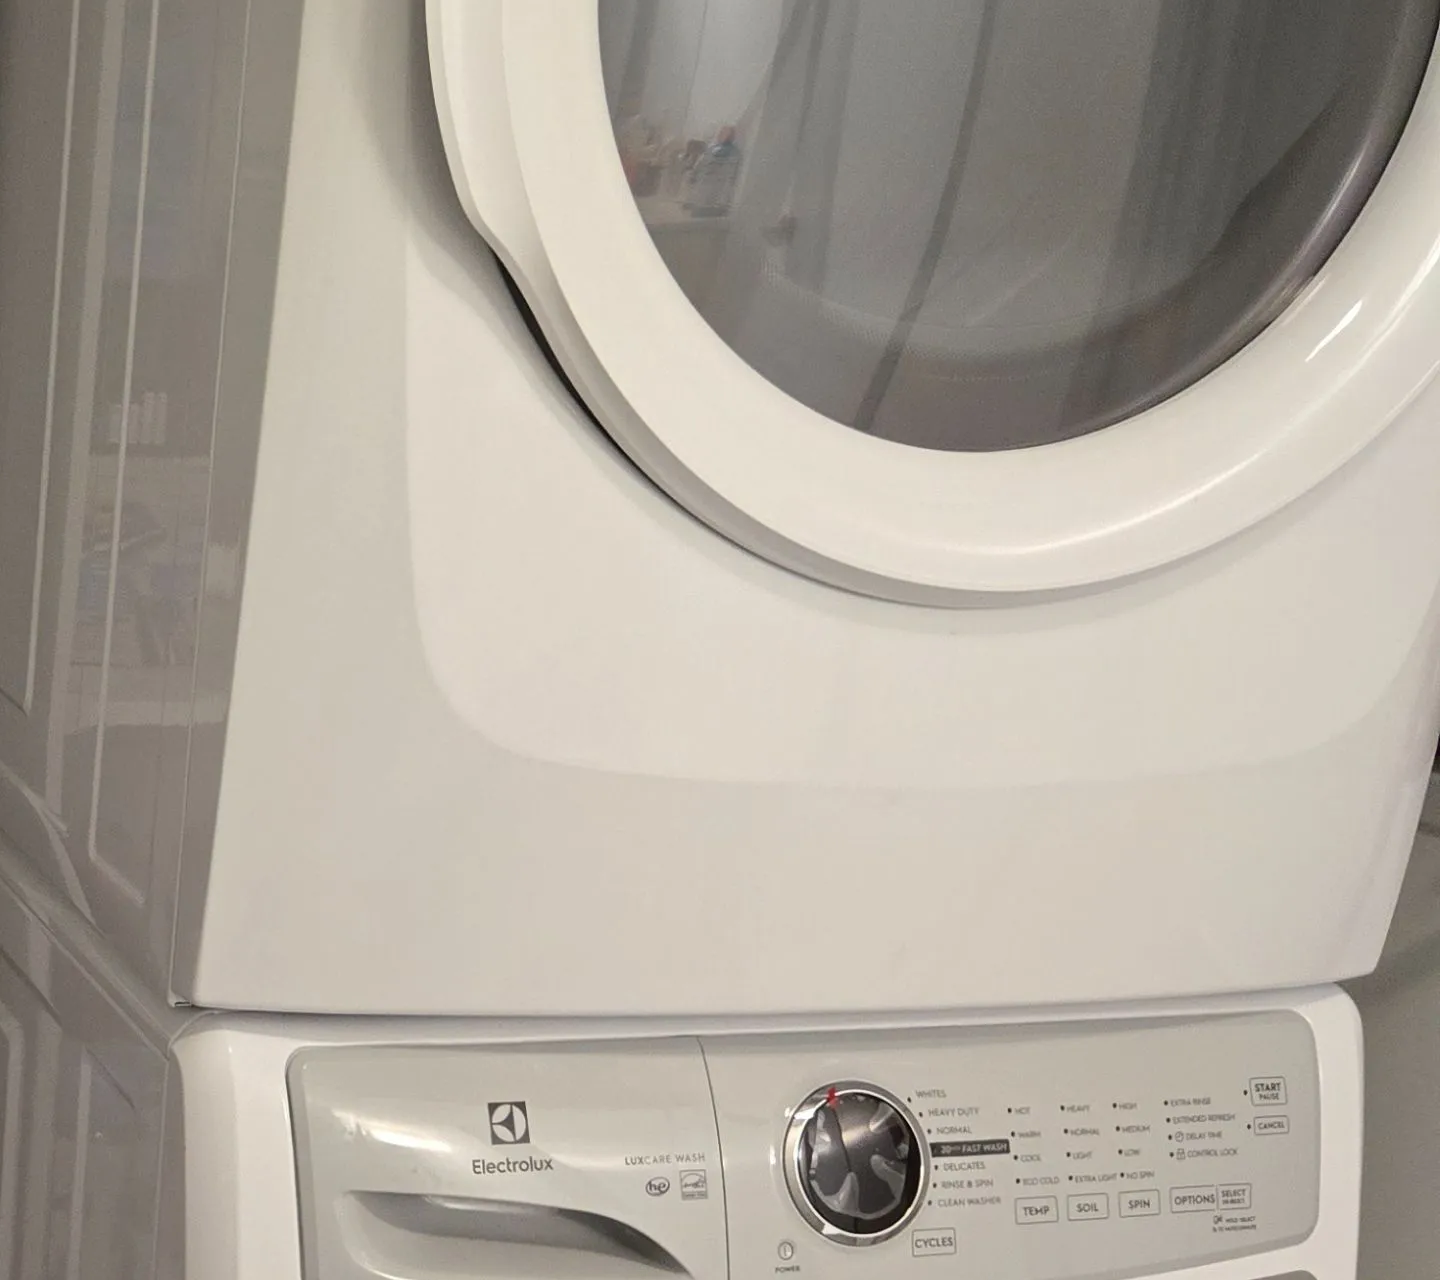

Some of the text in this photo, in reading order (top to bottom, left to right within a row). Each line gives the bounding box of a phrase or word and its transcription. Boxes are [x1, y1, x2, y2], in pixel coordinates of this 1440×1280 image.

[1254, 1082, 1281, 1092] START
[916, 1089, 947, 1098] WHITES
[928, 1106, 979, 1117] HEAVY DUTY
[936, 1126, 972, 1135] NORMAL
[1258, 1121, 1285, 1130] CANCEL
[962, 1142, 1007, 1153] FAST WASH
[624, 1152, 706, 1166] LUXCARE WASH
[472, 1156, 554, 1175] Electrolux
[943, 1161, 986, 1171] DELICATES
[1221, 1188, 1246, 1198] SELECT
[937, 1198, 965, 1207] CLEAN
[1128, 1198, 1151, 1210] SPIN
[1174, 1194, 1215, 1205] OPTIONS
[1022, 1205, 1050, 1216] TEMP
[1076, 1202, 1099, 1213] SOIL
[914, 1236, 954, 1248] CYCLES
[774, 1265, 801, 1274] POWER
